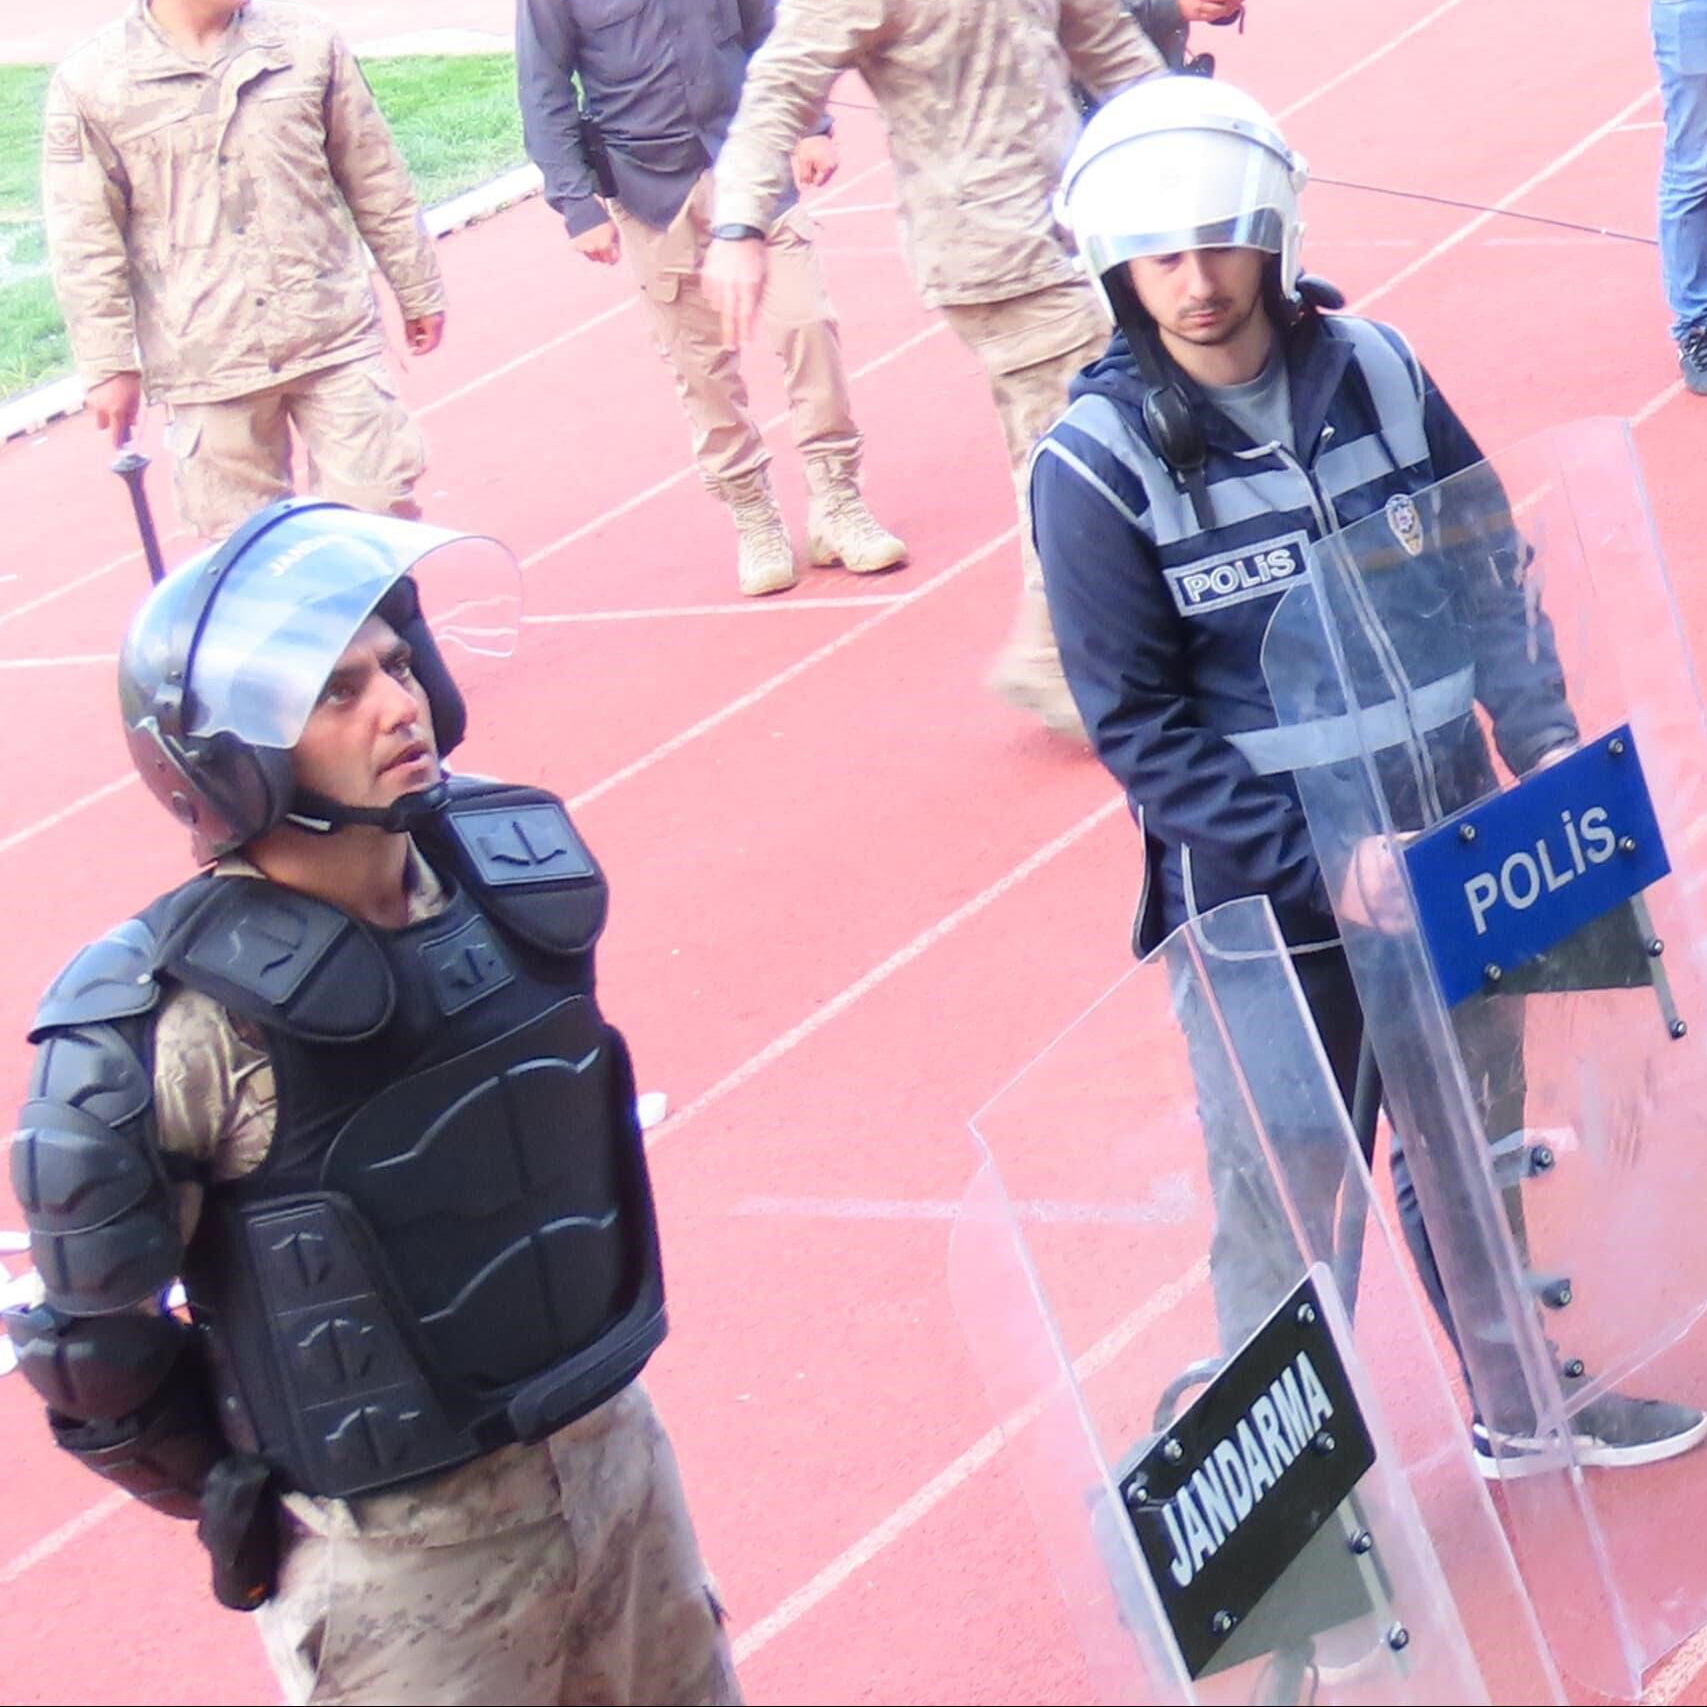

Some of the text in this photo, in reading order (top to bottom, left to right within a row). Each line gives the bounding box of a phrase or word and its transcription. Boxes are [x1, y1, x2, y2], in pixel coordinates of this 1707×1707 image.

[1183, 548, 1296, 603] POLİS
[1463, 805, 1617, 936] POLİS
[1160, 1349, 1335, 1589] JANDARMA
